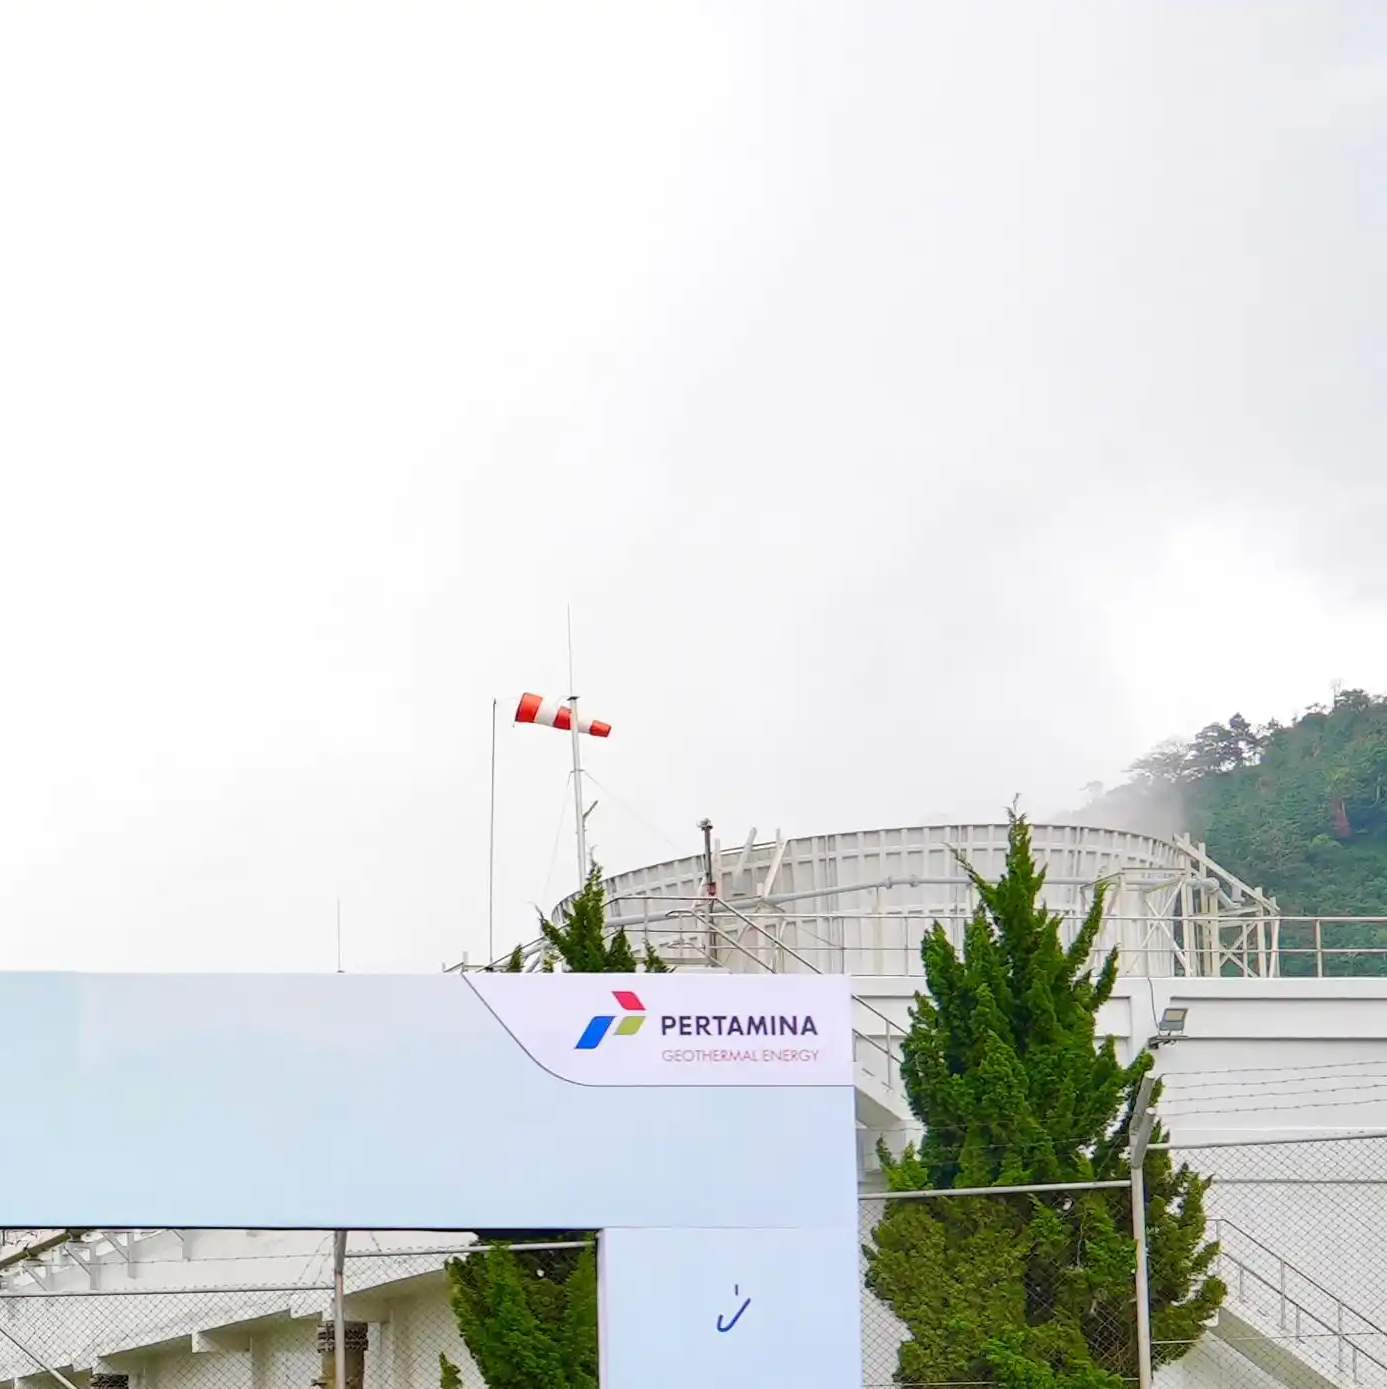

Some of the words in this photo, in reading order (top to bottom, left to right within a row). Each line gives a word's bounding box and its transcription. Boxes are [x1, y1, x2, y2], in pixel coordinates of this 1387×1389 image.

[661, 1015, 819, 1036] PERTAMINA
[661, 1048, 758, 1063] GEOTHERMAL
[762, 1048, 820, 1063] ENERGY
